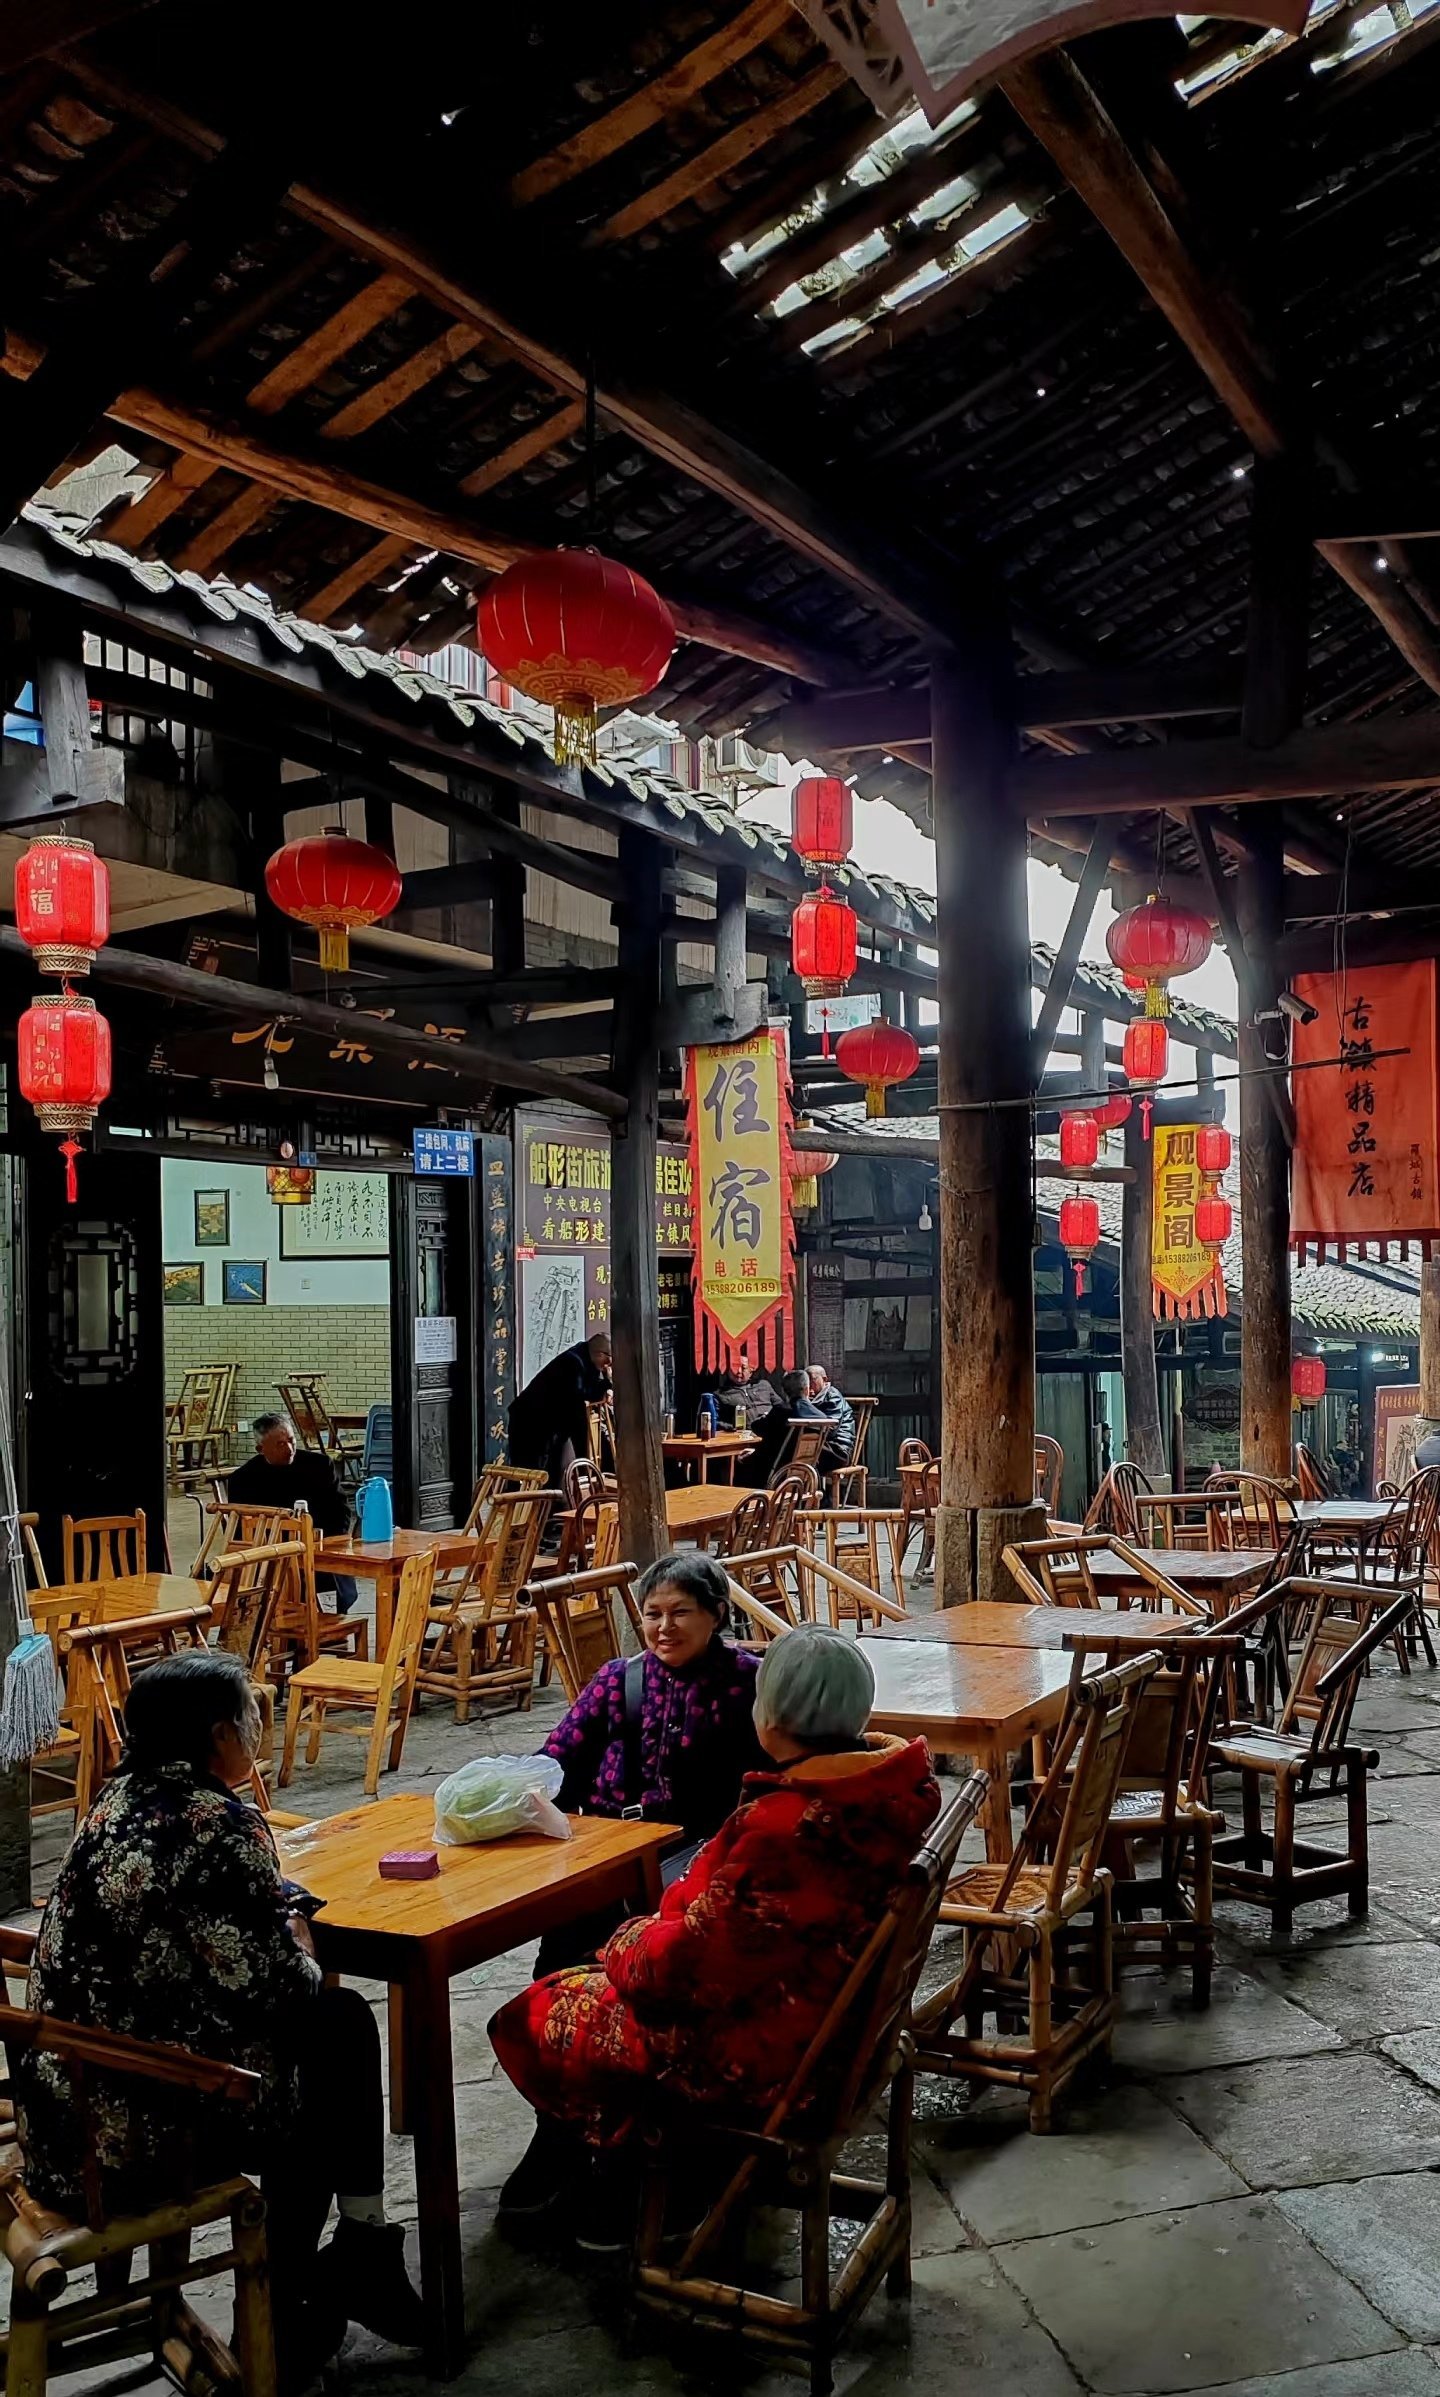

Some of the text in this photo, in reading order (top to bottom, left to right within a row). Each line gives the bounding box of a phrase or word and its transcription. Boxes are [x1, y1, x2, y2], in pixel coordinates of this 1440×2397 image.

[30, 887, 54, 914] 福
[419, 1153, 469, 1172] 请上二楼
[704, 1060, 771, 1249] 住宿
[1164, 1131, 1195, 1251] 观景阁
[543, 1193, 603, 1213] 中央电视台
[714, 1258, 758, 1277] 电话
[706, 1282, 775, 1294] 15388206189
